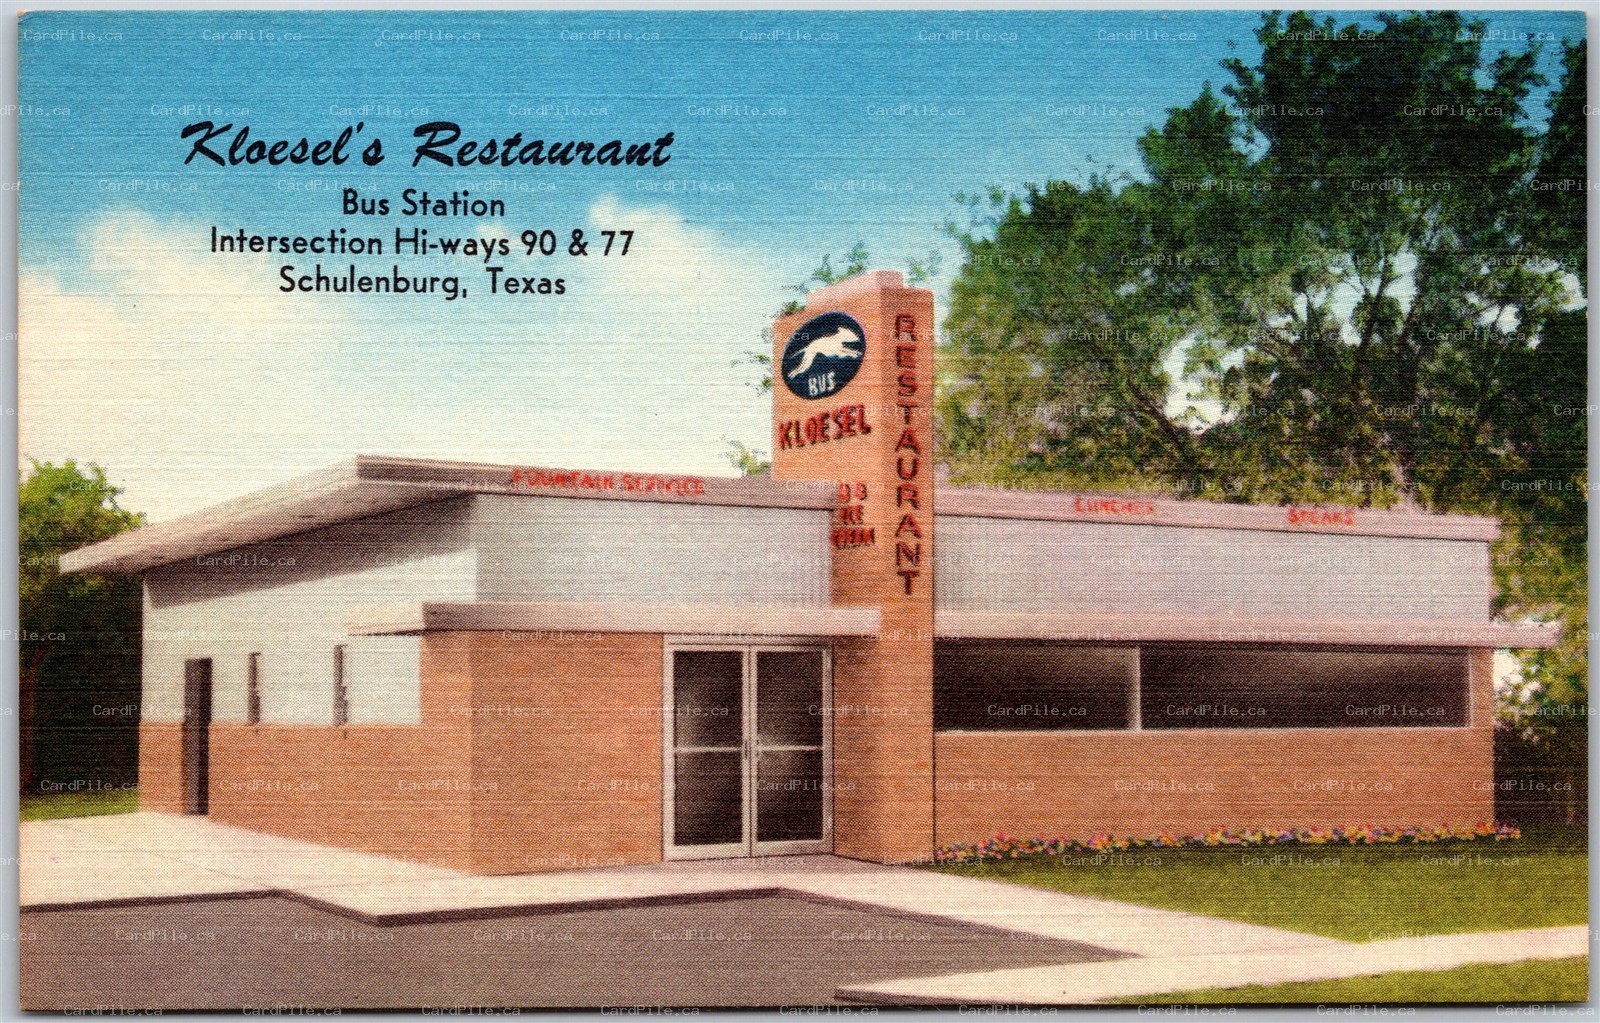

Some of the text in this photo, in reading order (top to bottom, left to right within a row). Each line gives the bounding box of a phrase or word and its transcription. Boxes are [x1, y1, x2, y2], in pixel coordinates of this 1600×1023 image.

[808, 372, 837, 397] BUS
[778, 404, 872, 450] KLOESEL
[894, 314, 923, 596] RESTAURANT
[1287, 507, 1354, 525] STEAKS
